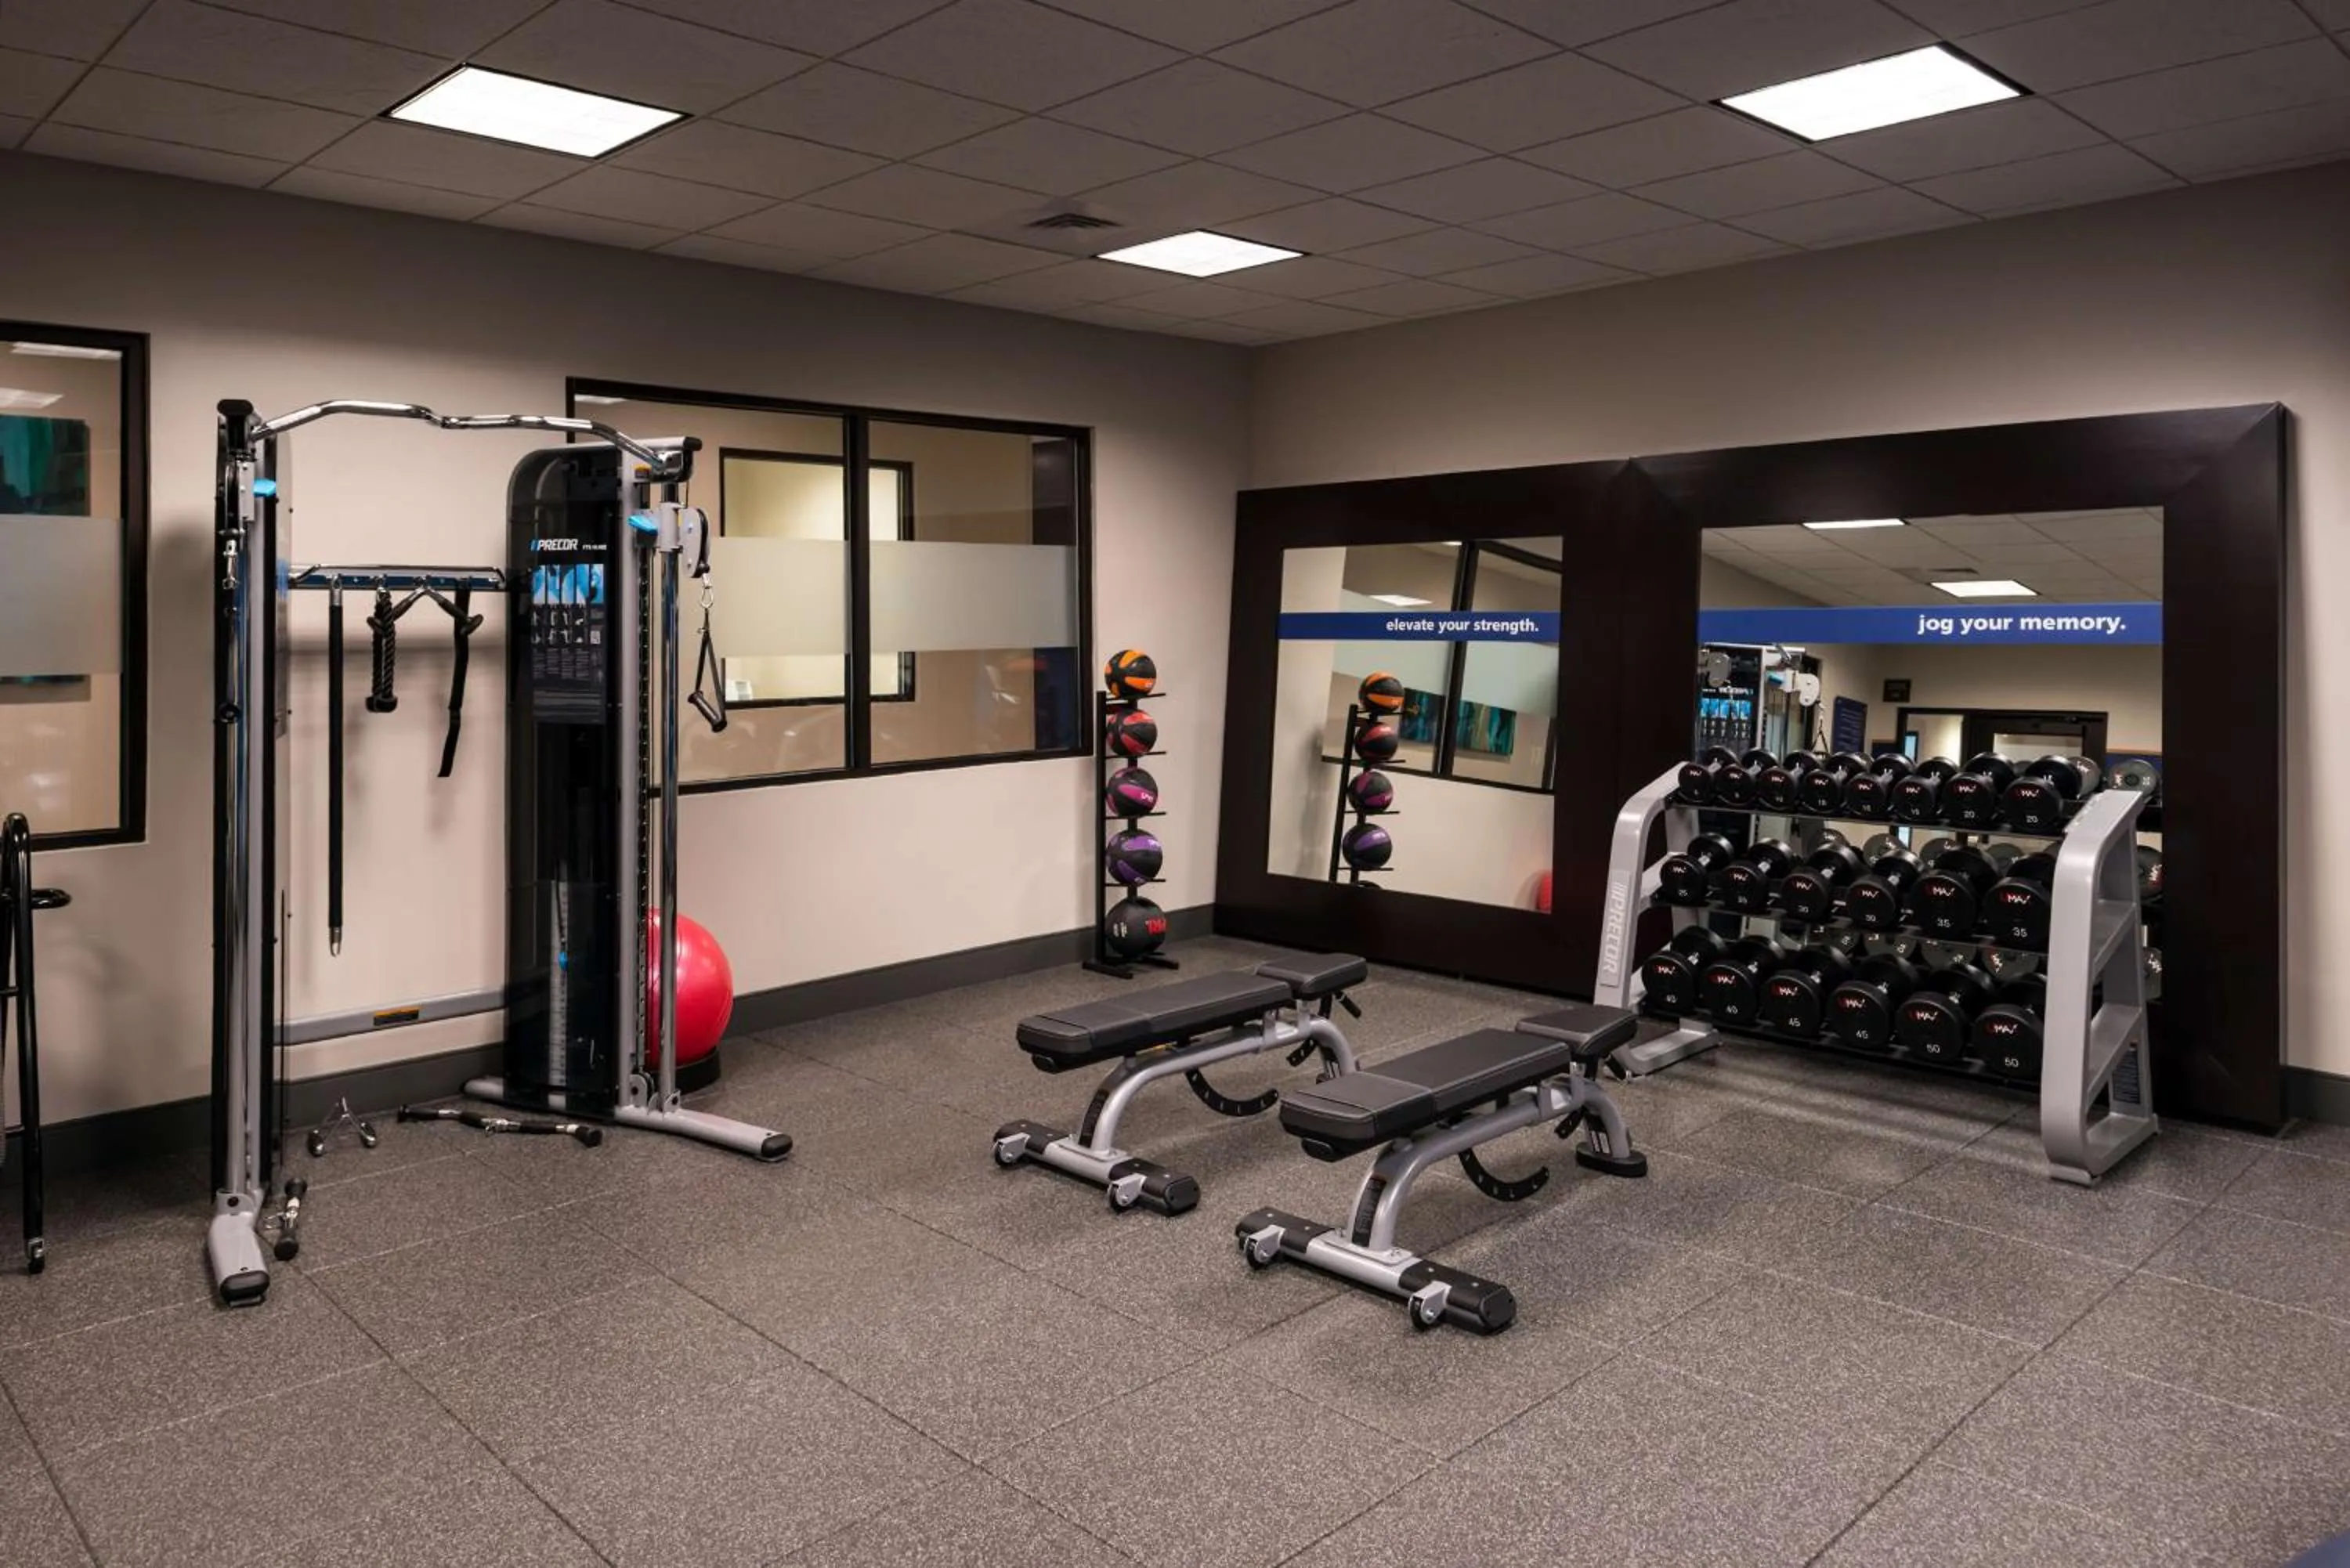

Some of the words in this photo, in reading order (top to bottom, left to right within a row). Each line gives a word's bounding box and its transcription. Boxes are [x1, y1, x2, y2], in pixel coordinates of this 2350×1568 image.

[537, 538, 578, 551] PRECOR
[1386, 617, 1434, 632] elevate
[1437, 618, 1470, 634] your
[1473, 617, 1539, 636] strength.
[1917, 614, 1954, 635] jog
[1960, 616, 2014, 635] your
[2019, 615, 2127, 635] memory.
[1937, 918, 1950, 928] 35
[1602, 890, 1628, 974] PRECOR
[2012, 927, 2028, 938] 35
[1788, 1017, 1801, 1027] 45
